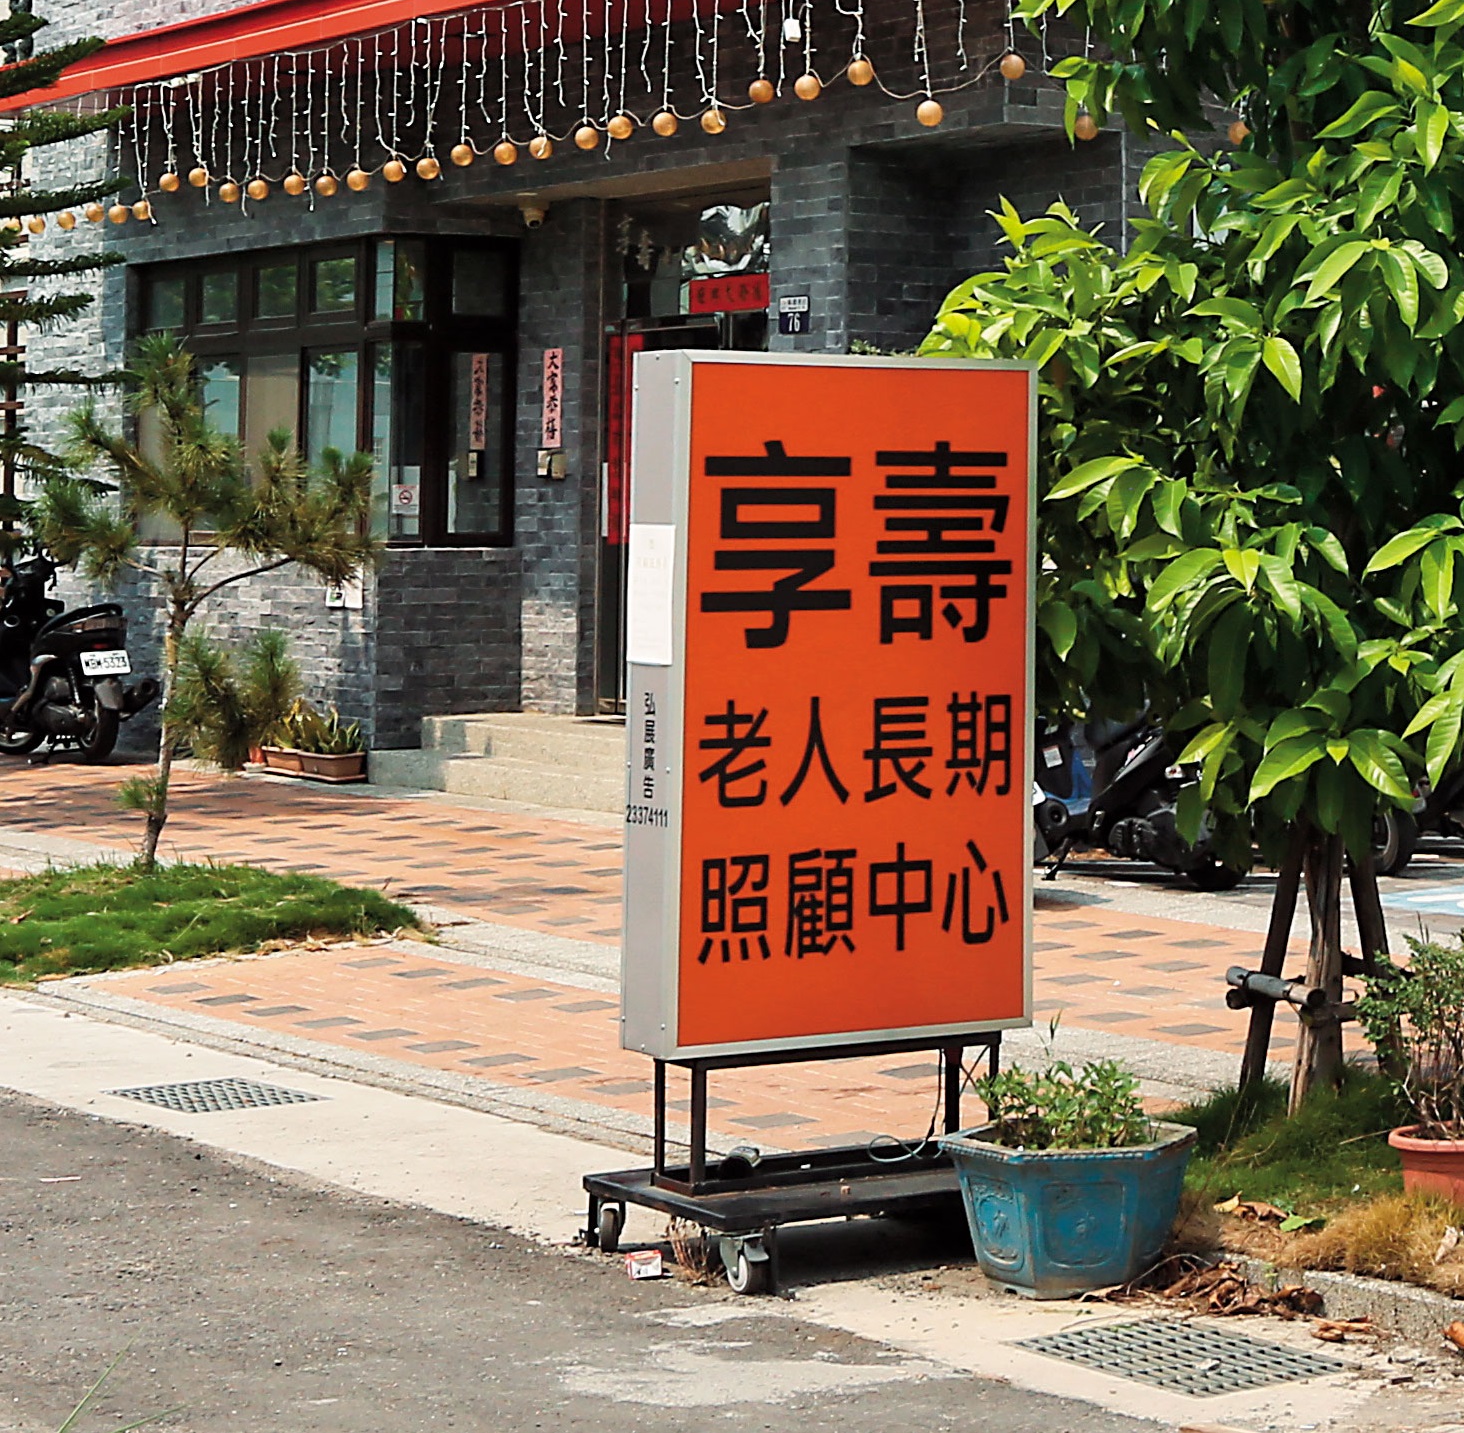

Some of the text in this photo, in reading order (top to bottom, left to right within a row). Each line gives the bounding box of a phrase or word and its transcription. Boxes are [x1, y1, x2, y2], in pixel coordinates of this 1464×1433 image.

[787, 313, 801, 332] 76
[700, 440, 1013, 650] 享壽
[643, 692, 656, 799] 弘展廣告
[698, 691, 1013, 808] 老人長期
[626, 803, 668, 828] 23374111
[697, 840, 1010, 965] 照顧中心
